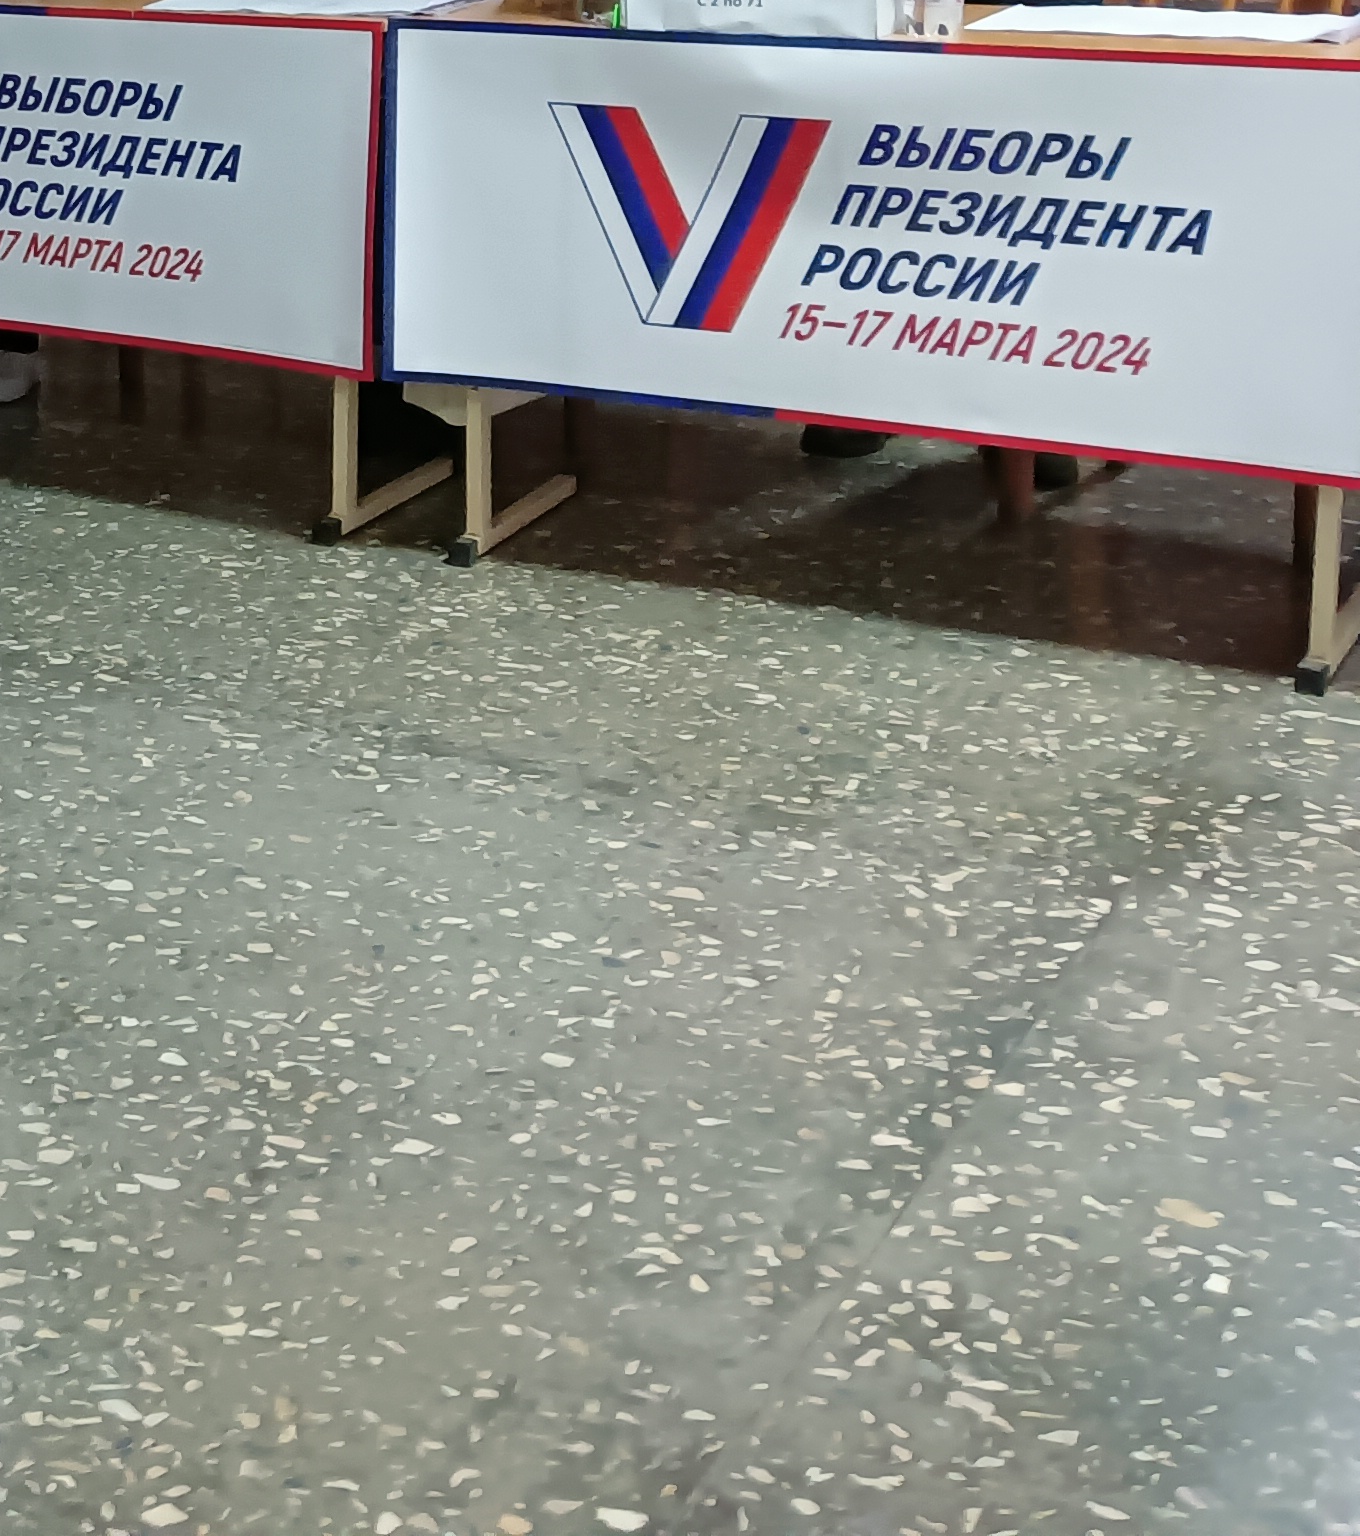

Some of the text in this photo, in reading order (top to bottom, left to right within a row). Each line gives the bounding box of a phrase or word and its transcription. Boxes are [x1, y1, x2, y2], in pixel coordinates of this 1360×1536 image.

[858, 123, 1133, 182] ВЫБОРЫ
[830, 185, 1213, 257] ПРЕЗИДЕНТА
[23, 234, 123, 274] МАРТА
[129, 244, 204, 283] 2024
[802, 244, 1039, 307] РОССИИ
[893, 314, 1038, 366] МАРТА
[1042, 329, 1151, 376] 2024
